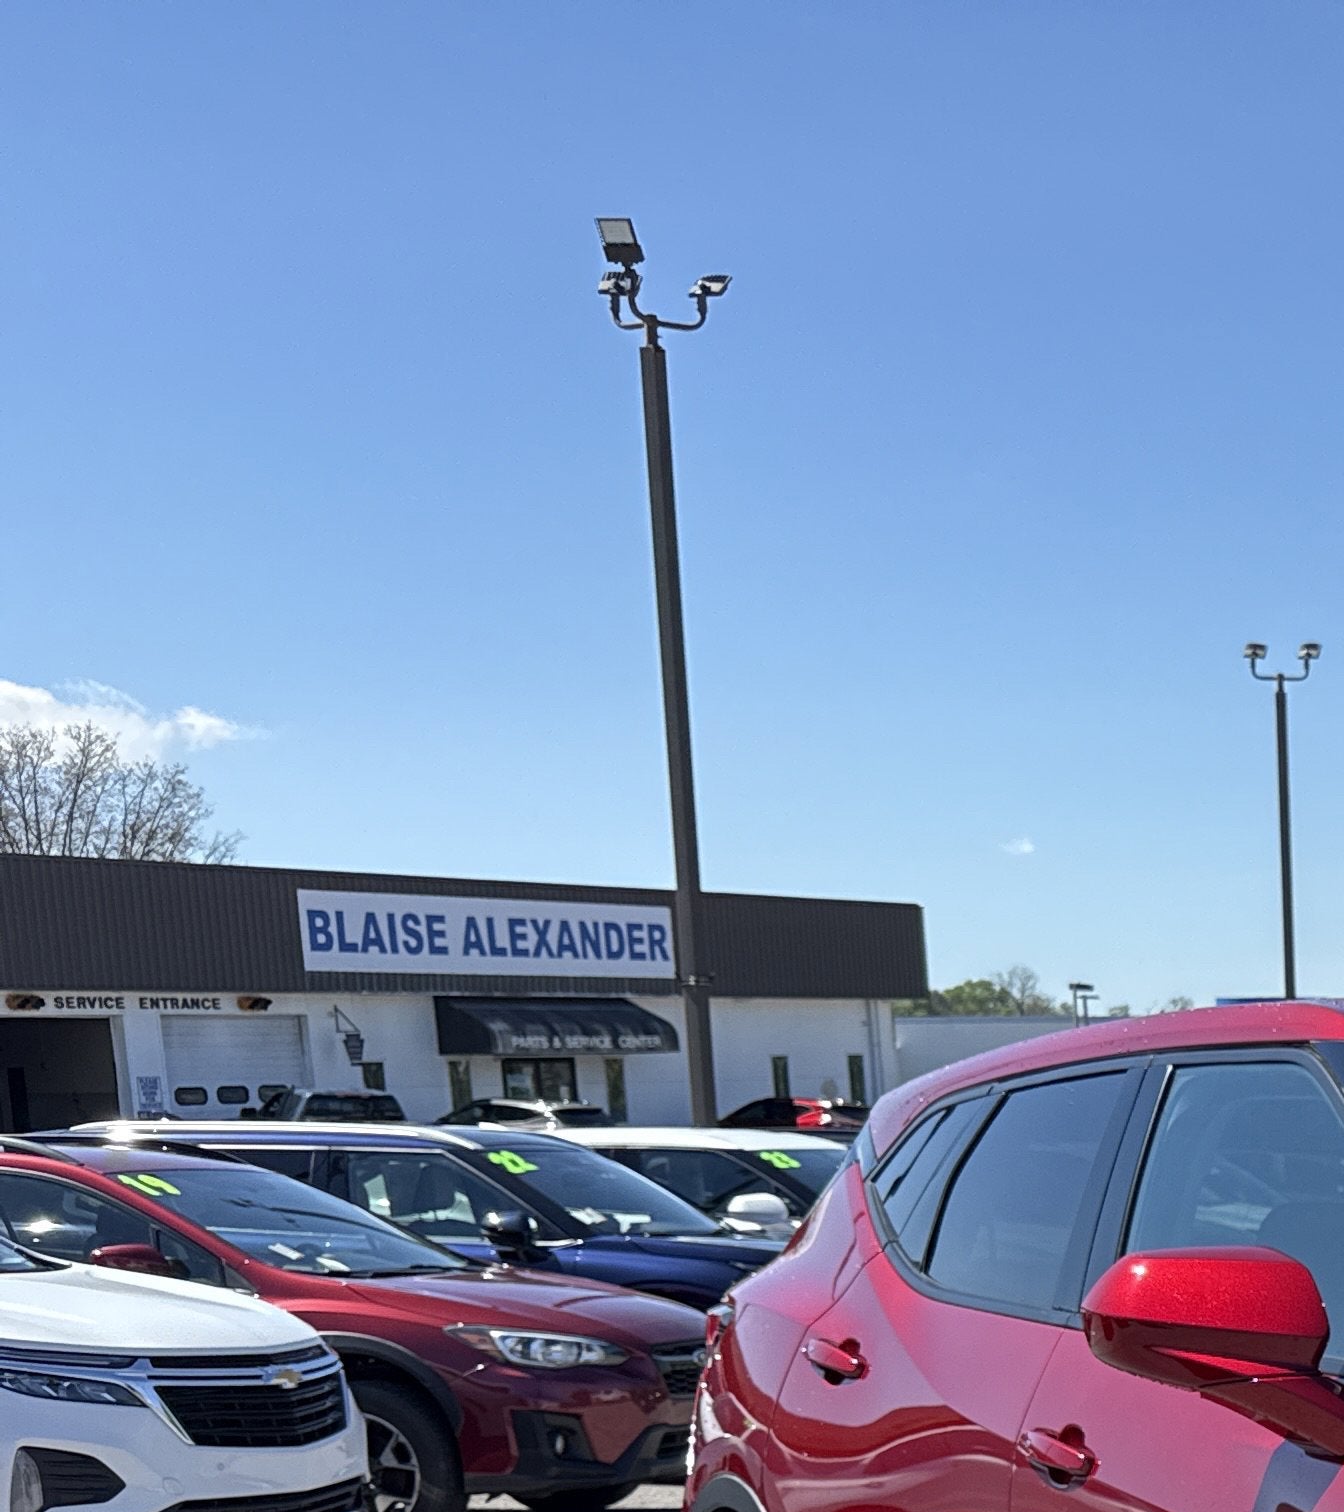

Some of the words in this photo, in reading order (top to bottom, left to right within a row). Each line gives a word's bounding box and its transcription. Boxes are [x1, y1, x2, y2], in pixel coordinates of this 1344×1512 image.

[306, 909, 449, 956] BLAISE
[462, 916, 671, 962] ALEXANDER
[54, 996, 126, 1010] SERVICE
[139, 997, 222, 1010] ENTRANCE
[512, 1035, 549, 1049] PARTS
[553, 1035, 562, 1049] &
[565, 1034, 614, 1049] SERVICE
[617, 1035, 663, 1049] CENTER
